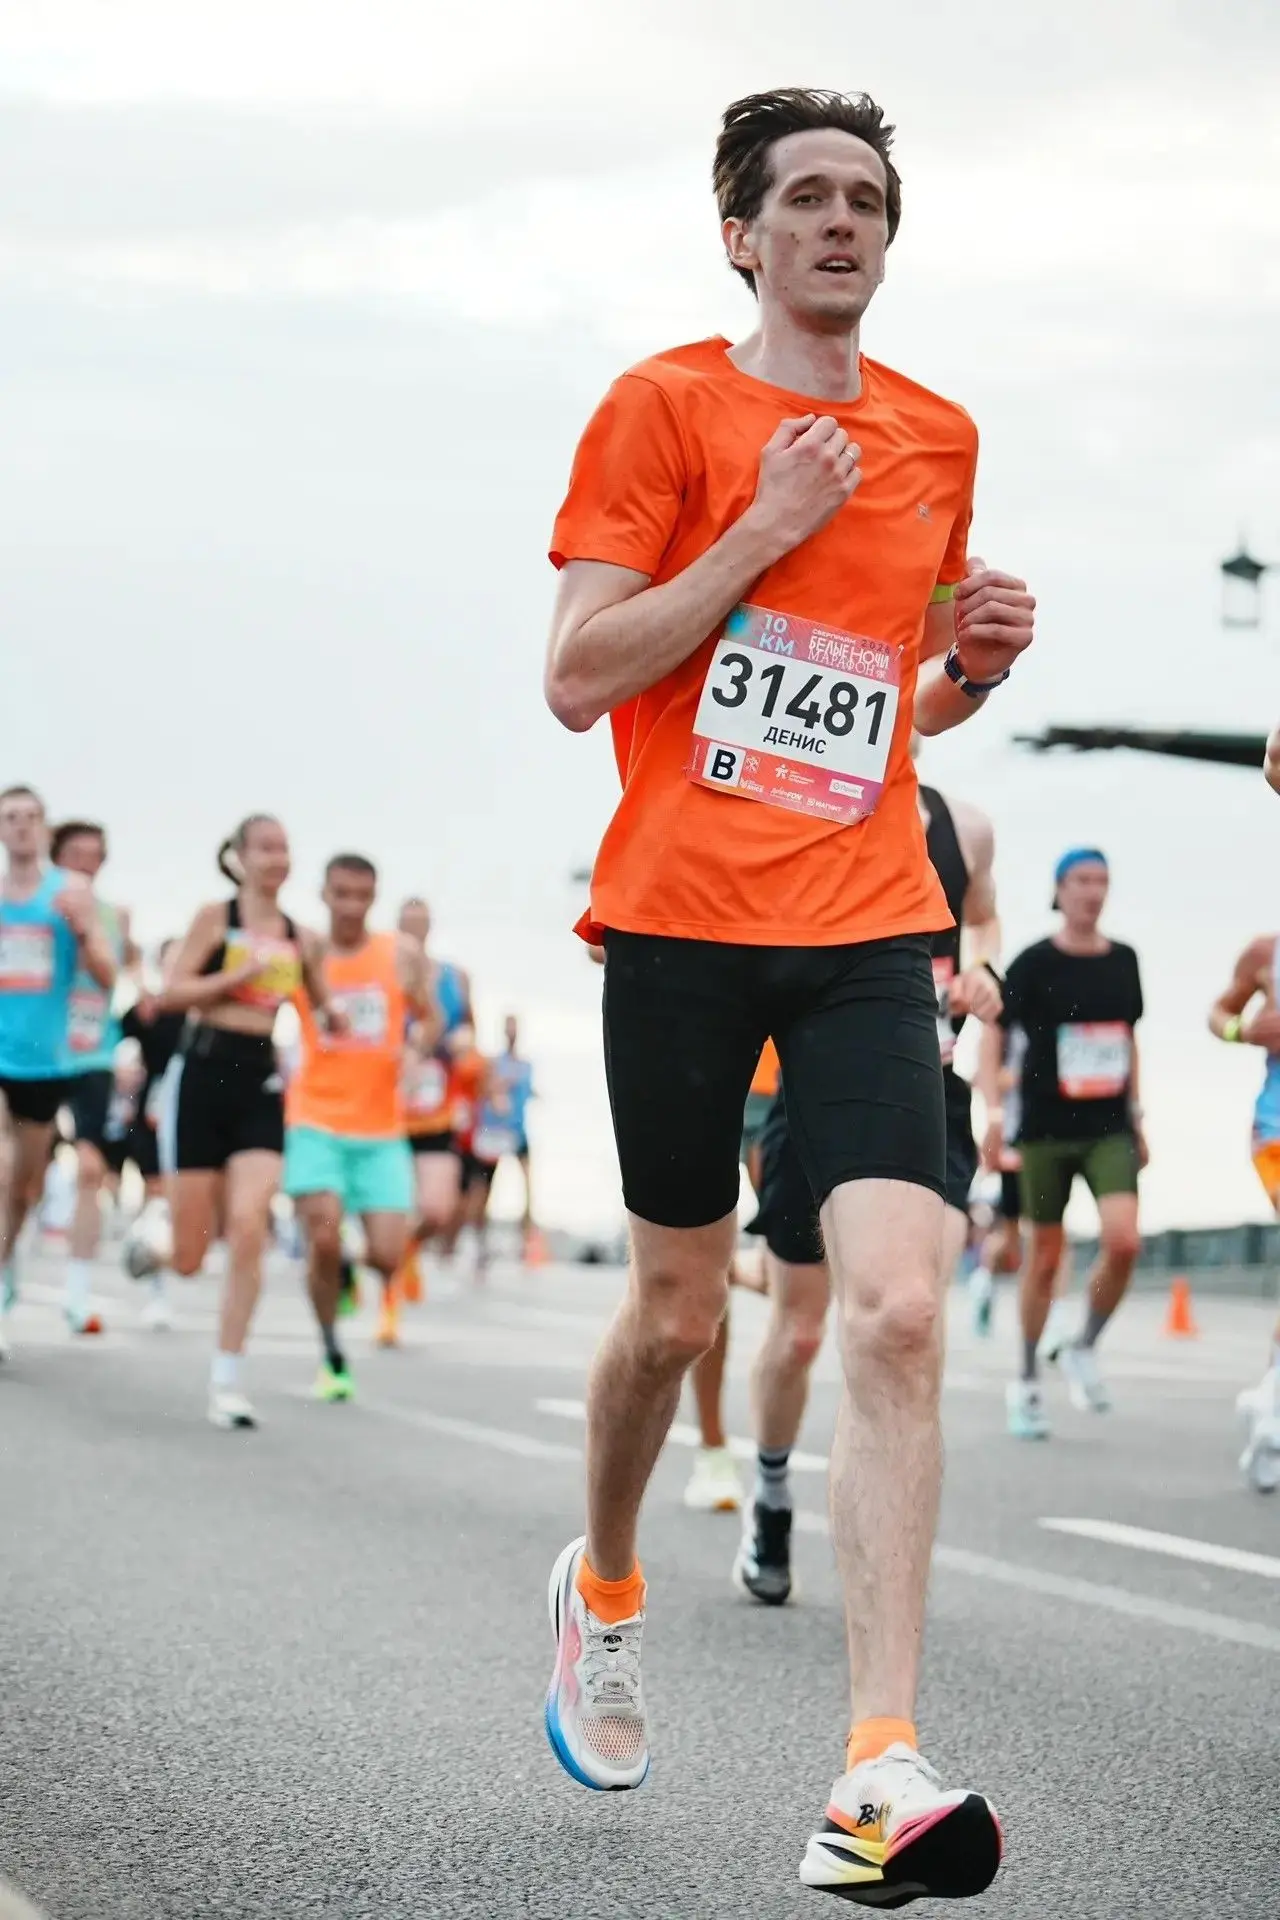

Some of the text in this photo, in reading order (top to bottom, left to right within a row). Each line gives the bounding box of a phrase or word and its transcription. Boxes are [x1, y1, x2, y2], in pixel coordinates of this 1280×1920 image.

[765, 614, 788, 633] 10
[808, 636, 889, 669] БЕЛЫЕ НОЧИ
[808, 649, 876, 677] МАРАФОН
[712, 653, 887, 746] 31481
[763, 726, 827, 754] ДЕНИС
